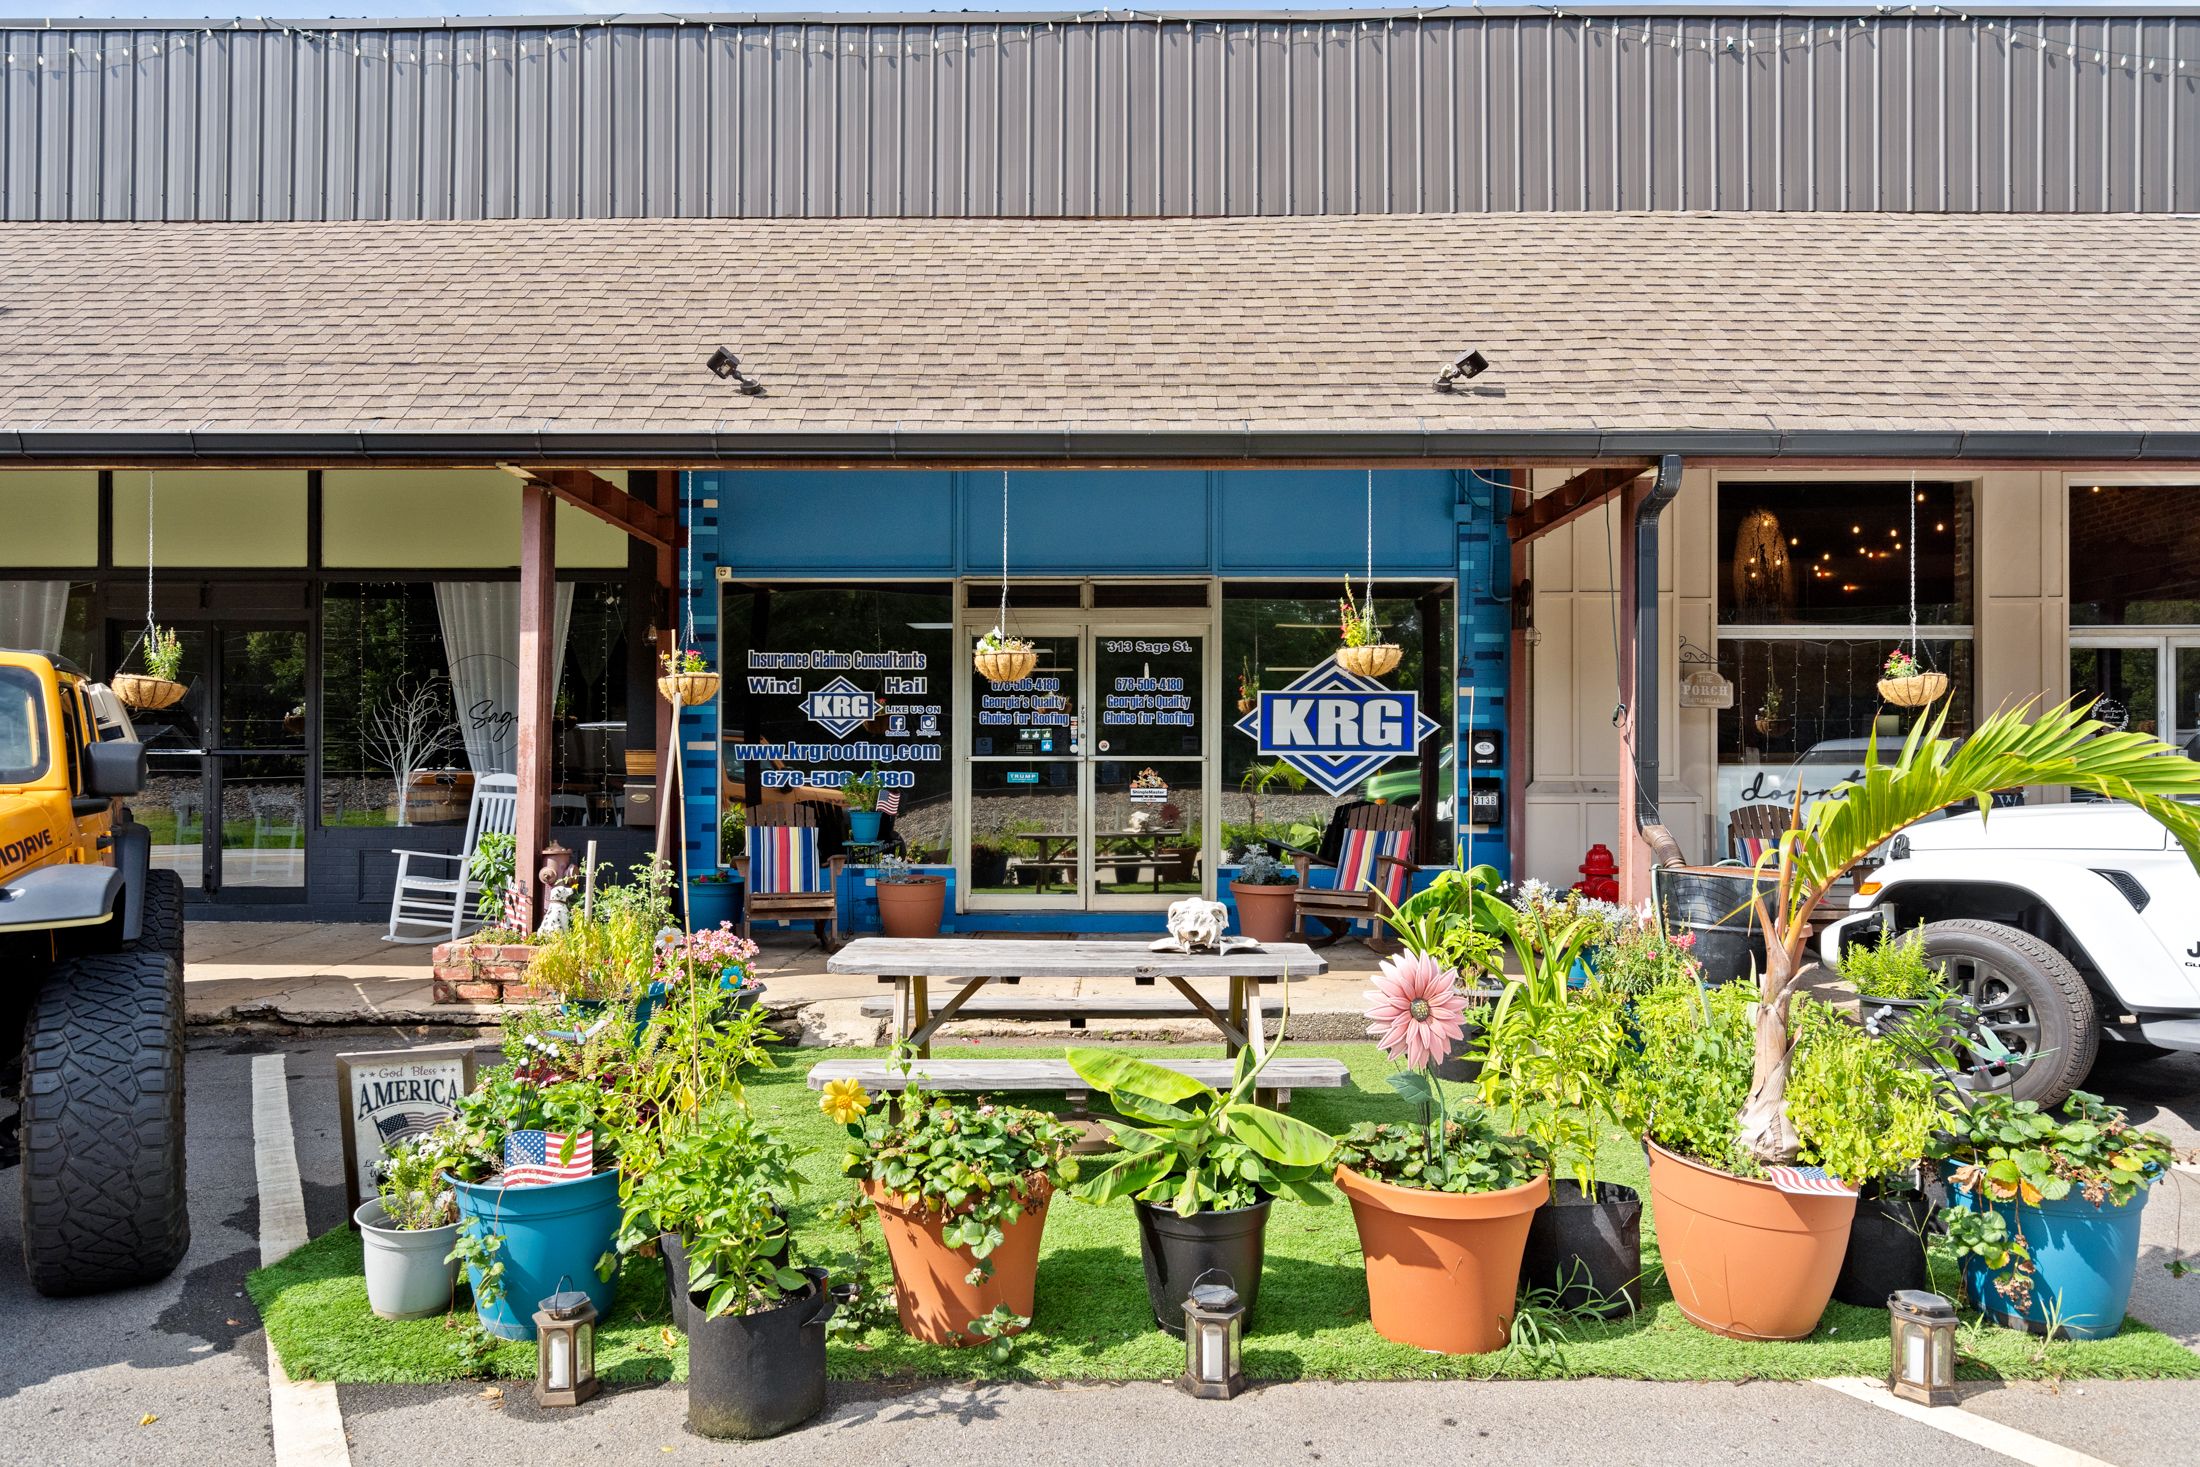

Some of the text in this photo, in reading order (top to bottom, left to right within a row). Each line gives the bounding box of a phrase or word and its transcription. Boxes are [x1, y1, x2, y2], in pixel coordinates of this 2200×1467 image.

[1107, 641, 1192, 655] 313 Sage St.
[748, 650, 926, 670] Insurance Claims Consultants
[748, 677, 801, 694] Wind
[885, 677, 927, 694] Hail
[1115, 677, 1184, 691] 678-506-4180
[1682, 685, 1728, 696] PORCH
[814, 696, 868, 717] KRG
[885, 705, 941, 714] LIKE US ON
[982, 695, 1029, 710] Georgia's
[1106, 695, 1154, 710] Georgia's
[469, 700, 518, 742] Sag
[979, 711, 1012, 725] Choice
[1013, 711, 1030, 725] for
[1031, 711, 1069, 727] Roofing
[1103, 711, 1194, 727] Choice for Roofing
[1273, 699, 1402, 746] KRG
[735, 741, 942, 763] www.krgroofing.com
[1474, 796, 1496, 805] 313B
[379, 1065, 437, 1078] God Bless
[358, 1079, 463, 1120] AMERICA
